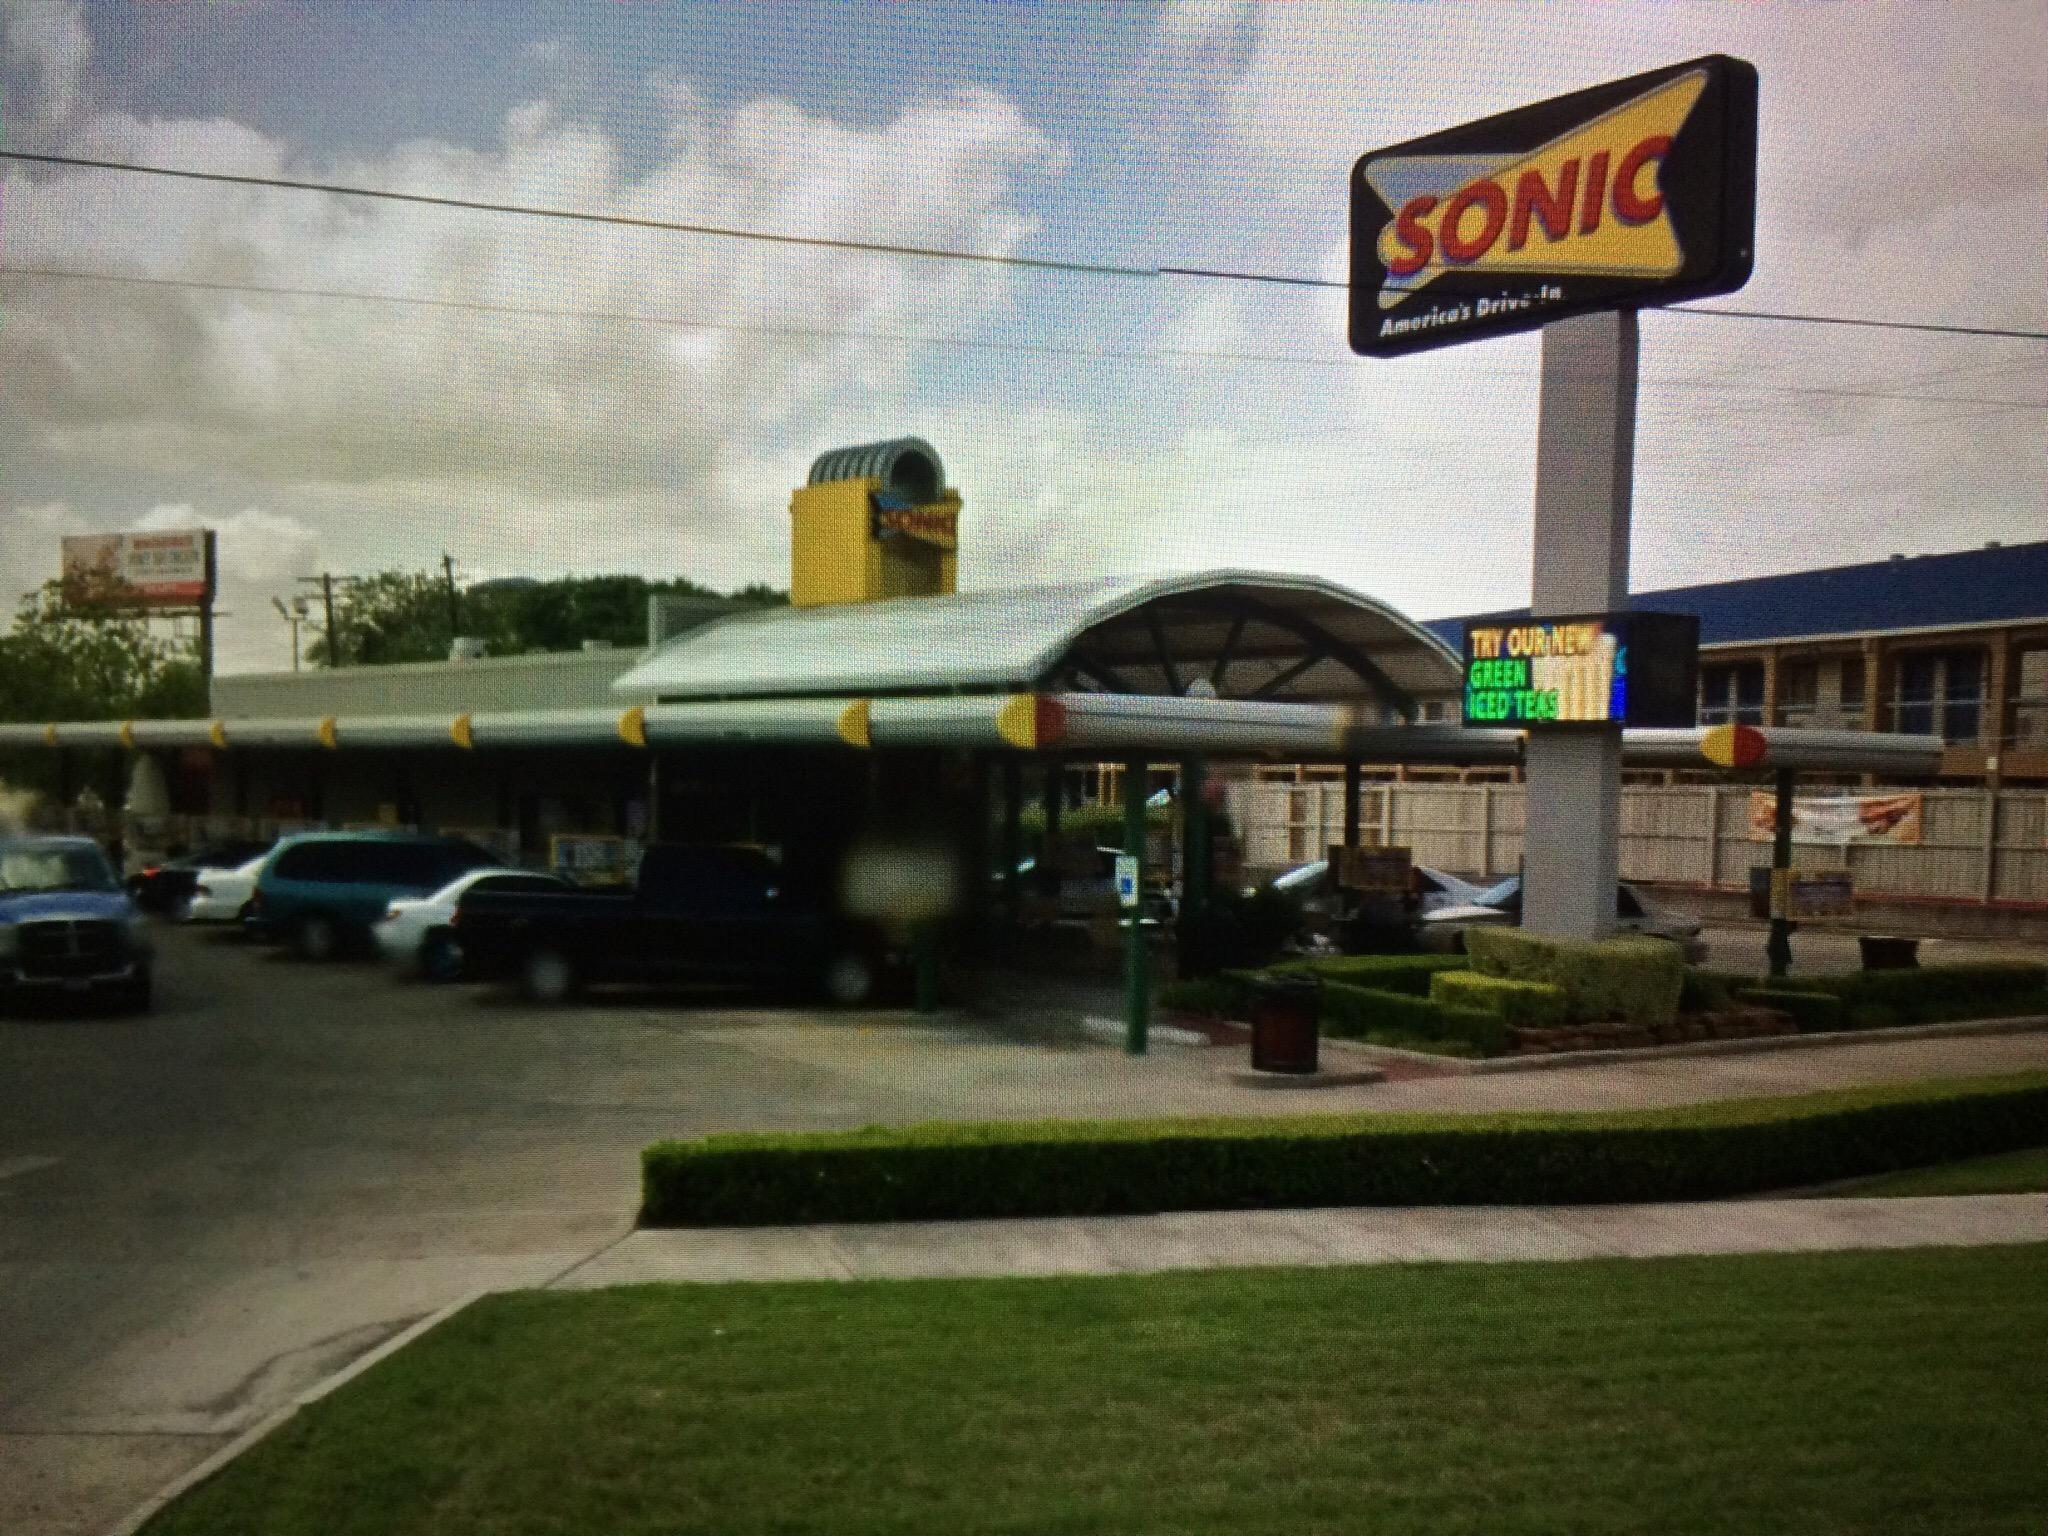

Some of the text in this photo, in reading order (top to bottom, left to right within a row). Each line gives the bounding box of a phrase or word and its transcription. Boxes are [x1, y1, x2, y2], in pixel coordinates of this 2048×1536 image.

[1386, 135, 1674, 276] SONIC
[1380, 303, 1470, 337] America's
[1470, 628, 1503, 658] TRY
[1507, 625, 1547, 657] OUR
[1469, 658, 1527, 689] GREEN
[1469, 688, 1559, 720] ICED TEAS
